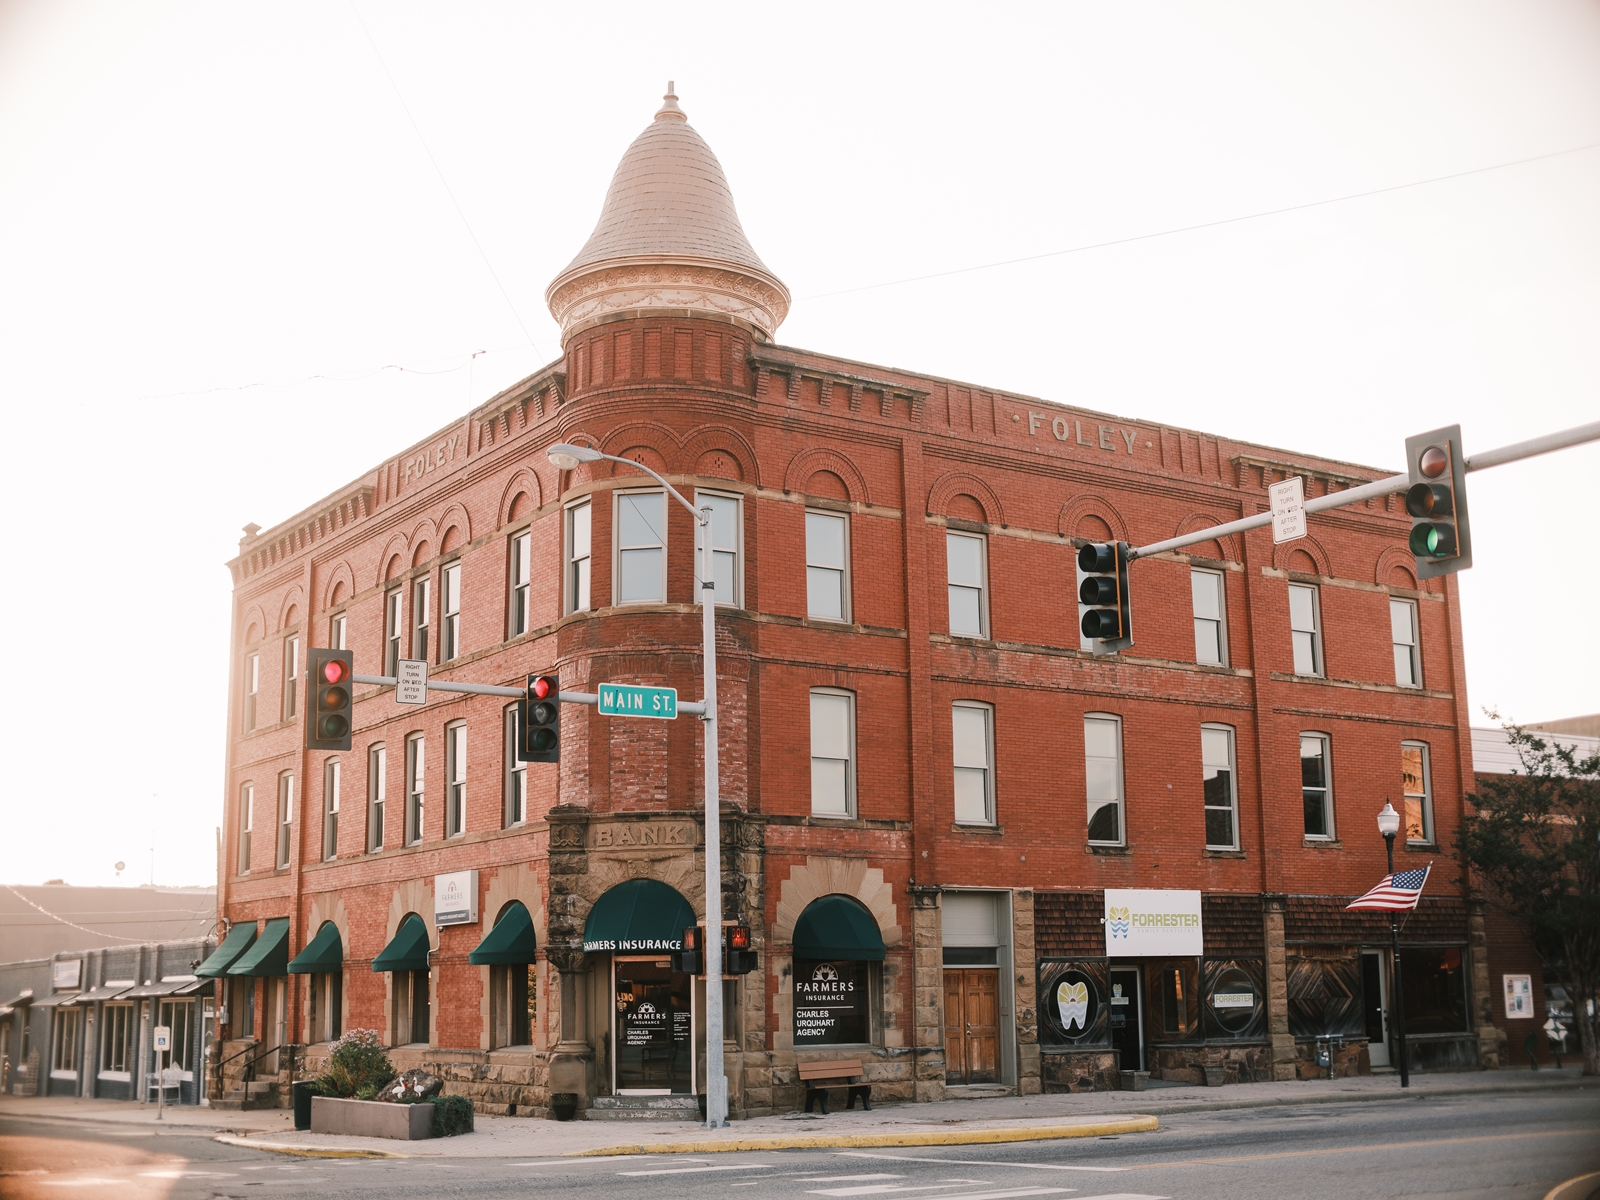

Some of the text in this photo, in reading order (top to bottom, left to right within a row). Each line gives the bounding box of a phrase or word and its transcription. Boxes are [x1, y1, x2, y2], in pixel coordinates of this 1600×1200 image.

[1028, 411, 1137, 455] FOLEY
[406, 434, 459, 485] FOLEY
[1278, 486, 1293, 495] RIGHT
[1280, 496, 1294, 505] TURN
[1287, 505, 1298, 513] RED
[1281, 516, 1297, 525] AFTER
[1283, 526, 1297, 535] STOP
[603, 691, 672, 712] MAIN ST.
[597, 826, 685, 846] BANK
[1132, 914, 1199, 926] FORRESTER
[583, 940, 682, 952] FARMERS INSURANCE
[796, 982, 854, 992] FARMERS
